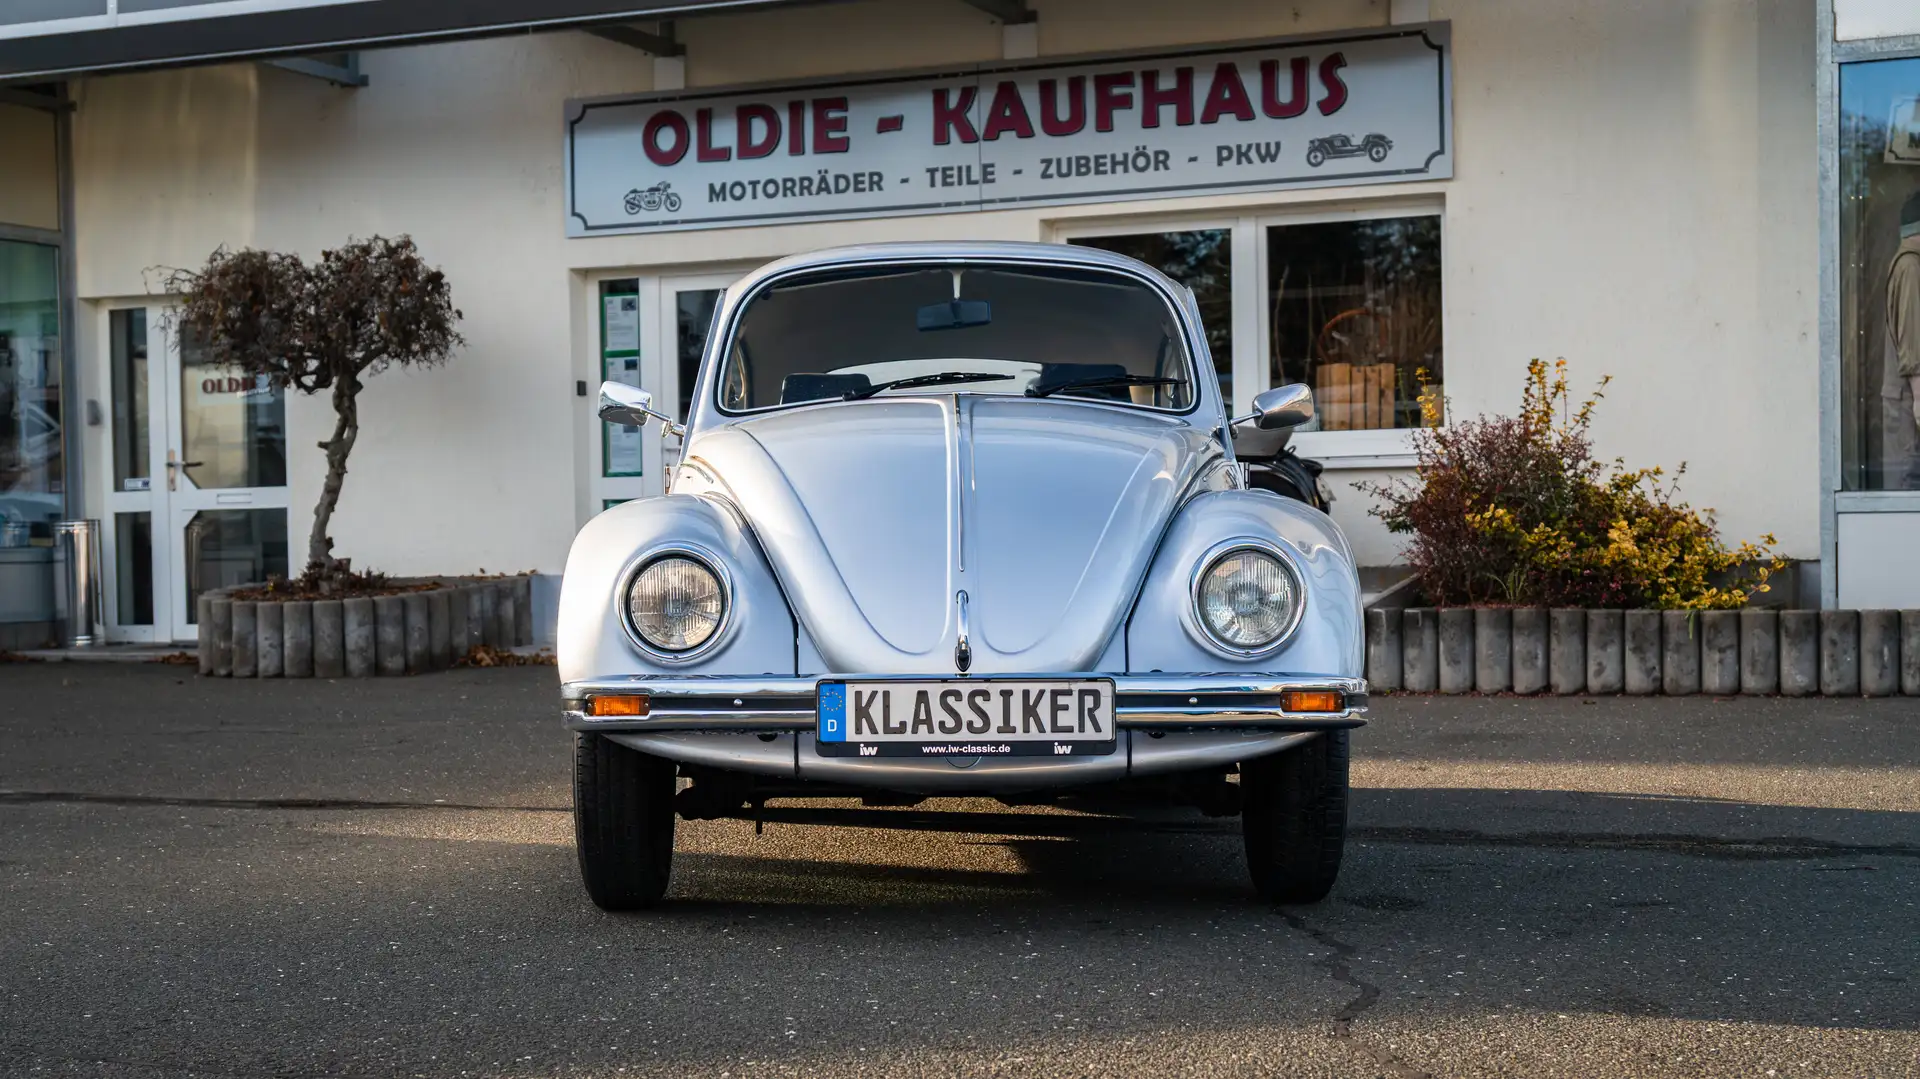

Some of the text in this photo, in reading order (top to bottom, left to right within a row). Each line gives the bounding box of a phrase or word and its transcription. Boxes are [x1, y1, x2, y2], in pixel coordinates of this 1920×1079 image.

[642, 97, 850, 167] OLDIE
[932, 52, 1347, 146] KAUFHAUS
[708, 170, 883, 203] MOTORRÄDER
[926, 163, 996, 188] TEILE
[1040, 146, 1170, 180] ZUBEHÖR
[1216, 140, 1281, 167] PKW
[854, 688, 1102, 734] KLASSIKER
[827, 719, 838, 732] D
[859, 743, 878, 756] iw
[922, 744, 1011, 754] www.iw-classic.de
[1054, 742, 1072, 755] iw
